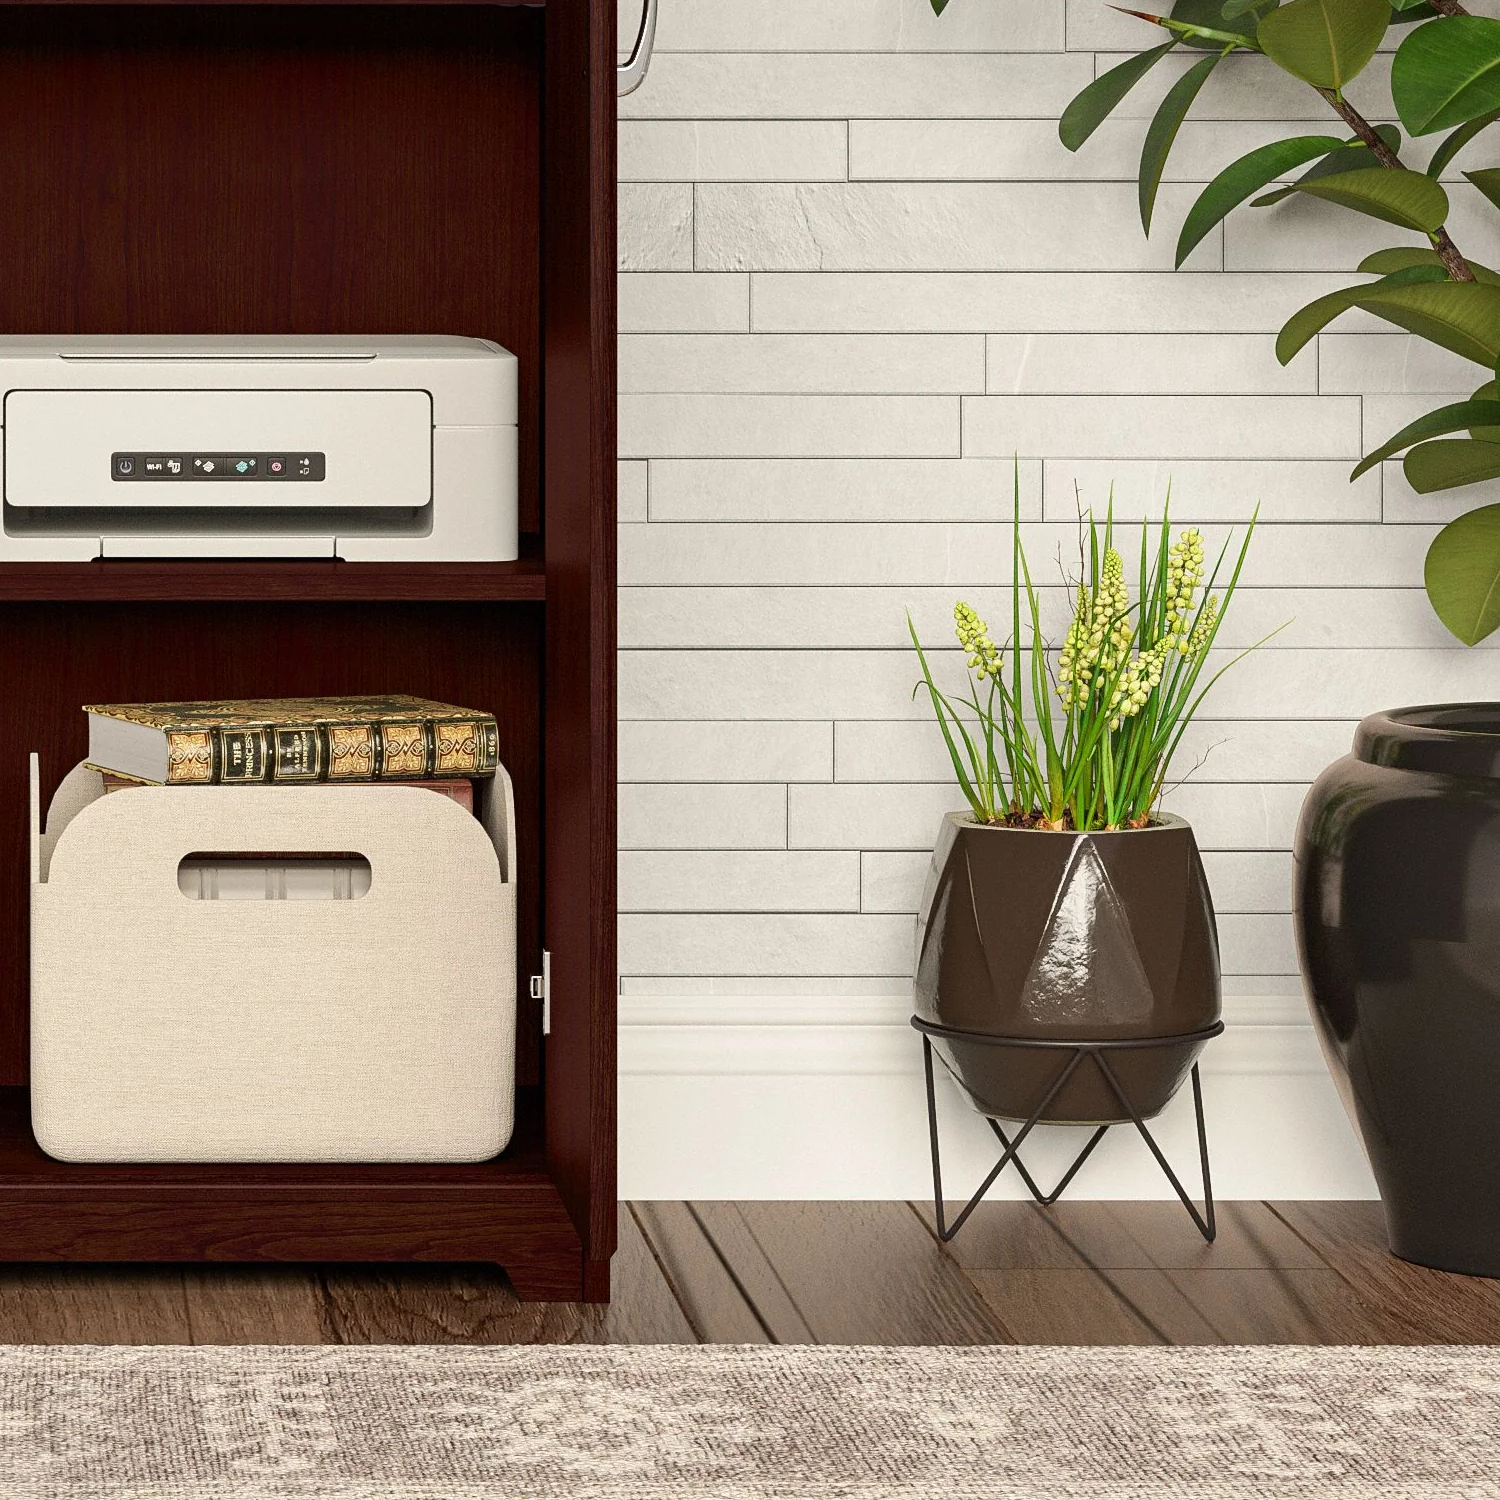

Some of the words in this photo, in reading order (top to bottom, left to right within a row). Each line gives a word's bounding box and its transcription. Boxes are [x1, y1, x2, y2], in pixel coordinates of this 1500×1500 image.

[232, 741, 242, 766] THE
[244, 732, 254, 778] PRINCESS
[293, 734, 301, 770] ALFRED
[300, 731, 309, 773] TENNYSON
